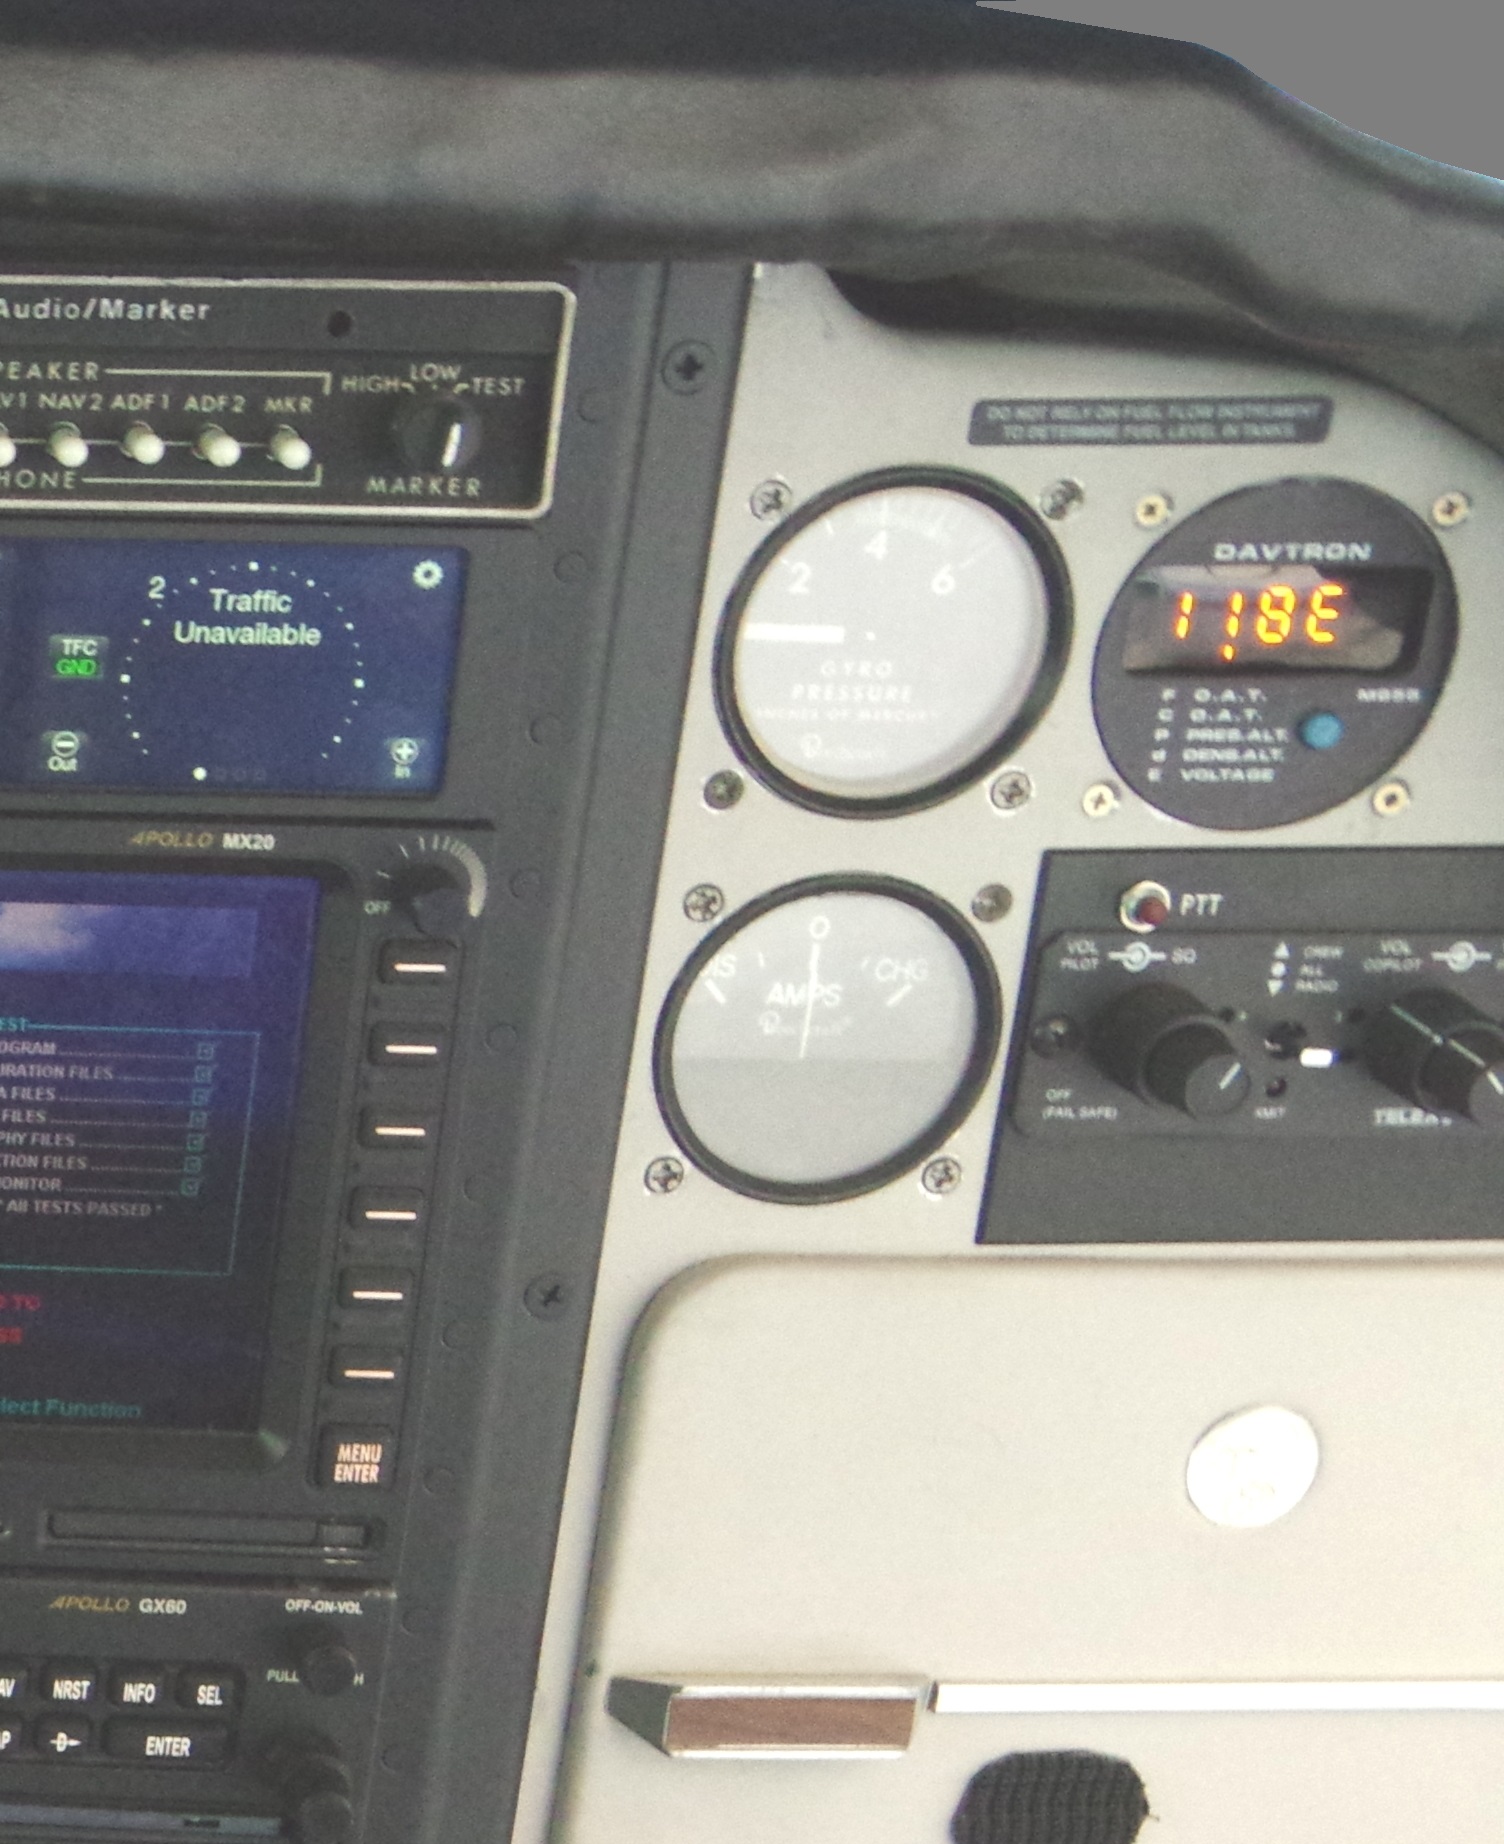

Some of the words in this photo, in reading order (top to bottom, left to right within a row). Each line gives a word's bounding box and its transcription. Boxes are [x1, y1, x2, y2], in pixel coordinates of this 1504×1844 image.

[410, 364, 462, 380] LOW
[342, 376, 399, 393] HIGH
[471, 377, 525, 395] TEST
[368, 477, 481, 496] MARKER
[1214, 543, 1372, 561] DAVTRON
[210, 587, 292, 613] Traffic
[174, 622, 321, 646] Unavailable
[63, 639, 97, 656] TFC
[57, 660, 96, 675] GND
[222, 833, 275, 850] MX20
[1180, 894, 1222, 916] PTT
[338, 1442, 382, 1465] MENU
[333, 1462, 381, 1485] ENTER
[139, 1598, 187, 1615] GX60
[53, 1679, 90, 1700] NRST
[123, 1682, 155, 1703] INFO
[197, 1685, 222, 1705] SEL
[145, 1736, 190, 1757] ENTER
